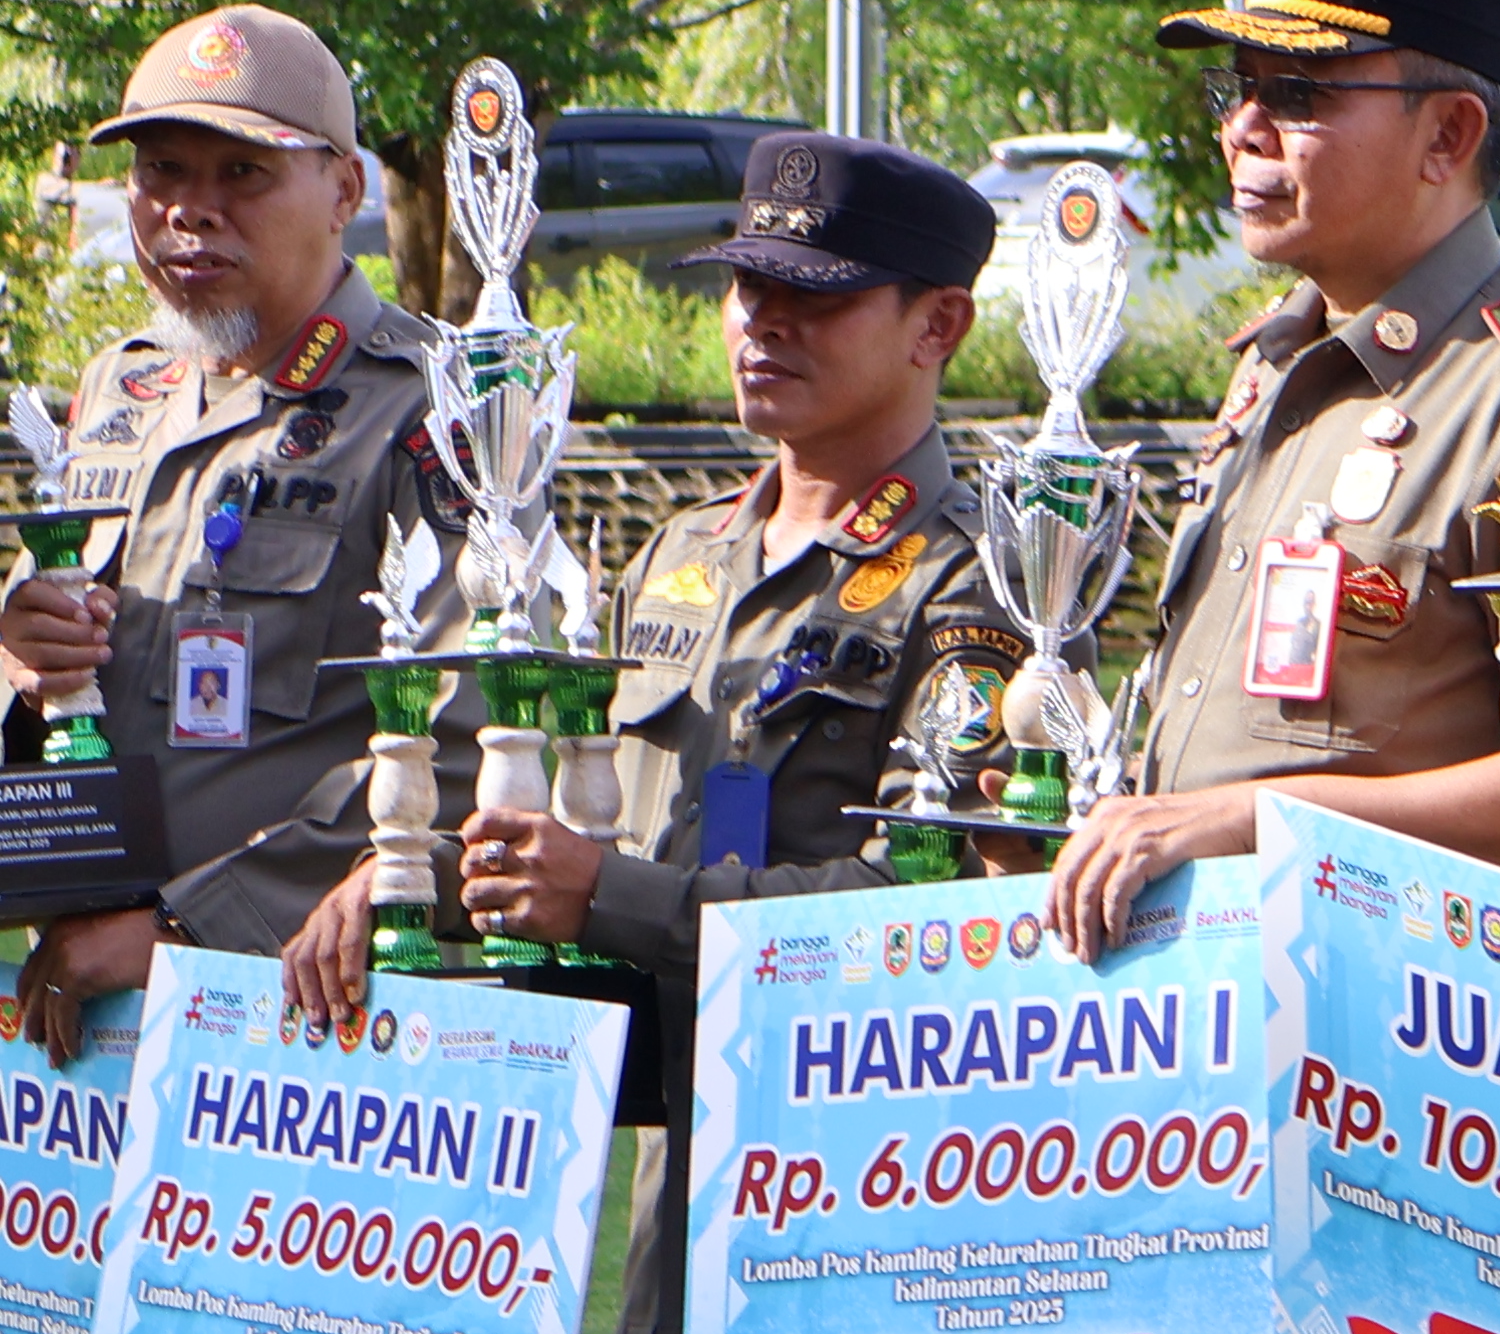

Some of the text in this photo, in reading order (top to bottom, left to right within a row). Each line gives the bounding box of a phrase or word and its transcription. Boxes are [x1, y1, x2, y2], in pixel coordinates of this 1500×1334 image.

[780, 933, 831, 955] bangga
[779, 965, 827, 986] bangsa
[795, 989, 1232, 1099] HARAPAN I
[188, 1070, 537, 1191] HARAPAN II
[1293, 1056, 1398, 1155] Rp.
[733, 1149, 837, 1231] Rp.
[1323, 1171, 1399, 1221] Lomba
[1402, 1198, 1444, 1236] Pos
[140, 1179, 552, 1314] Rp. 5.000.000,-
[743, 1223, 1269, 1283] Lomba Pos Kamling Kelurahan Tingkat Provinsi
[138, 1279, 193, 1313] Lomba
[194, 1288, 225, 1317] Pos
[227, 1295, 297, 1334] Kamling
[894, 1269, 1109, 1304] Kalimantan Selatan
[935, 1298, 1064, 1331] Tahun 2025
